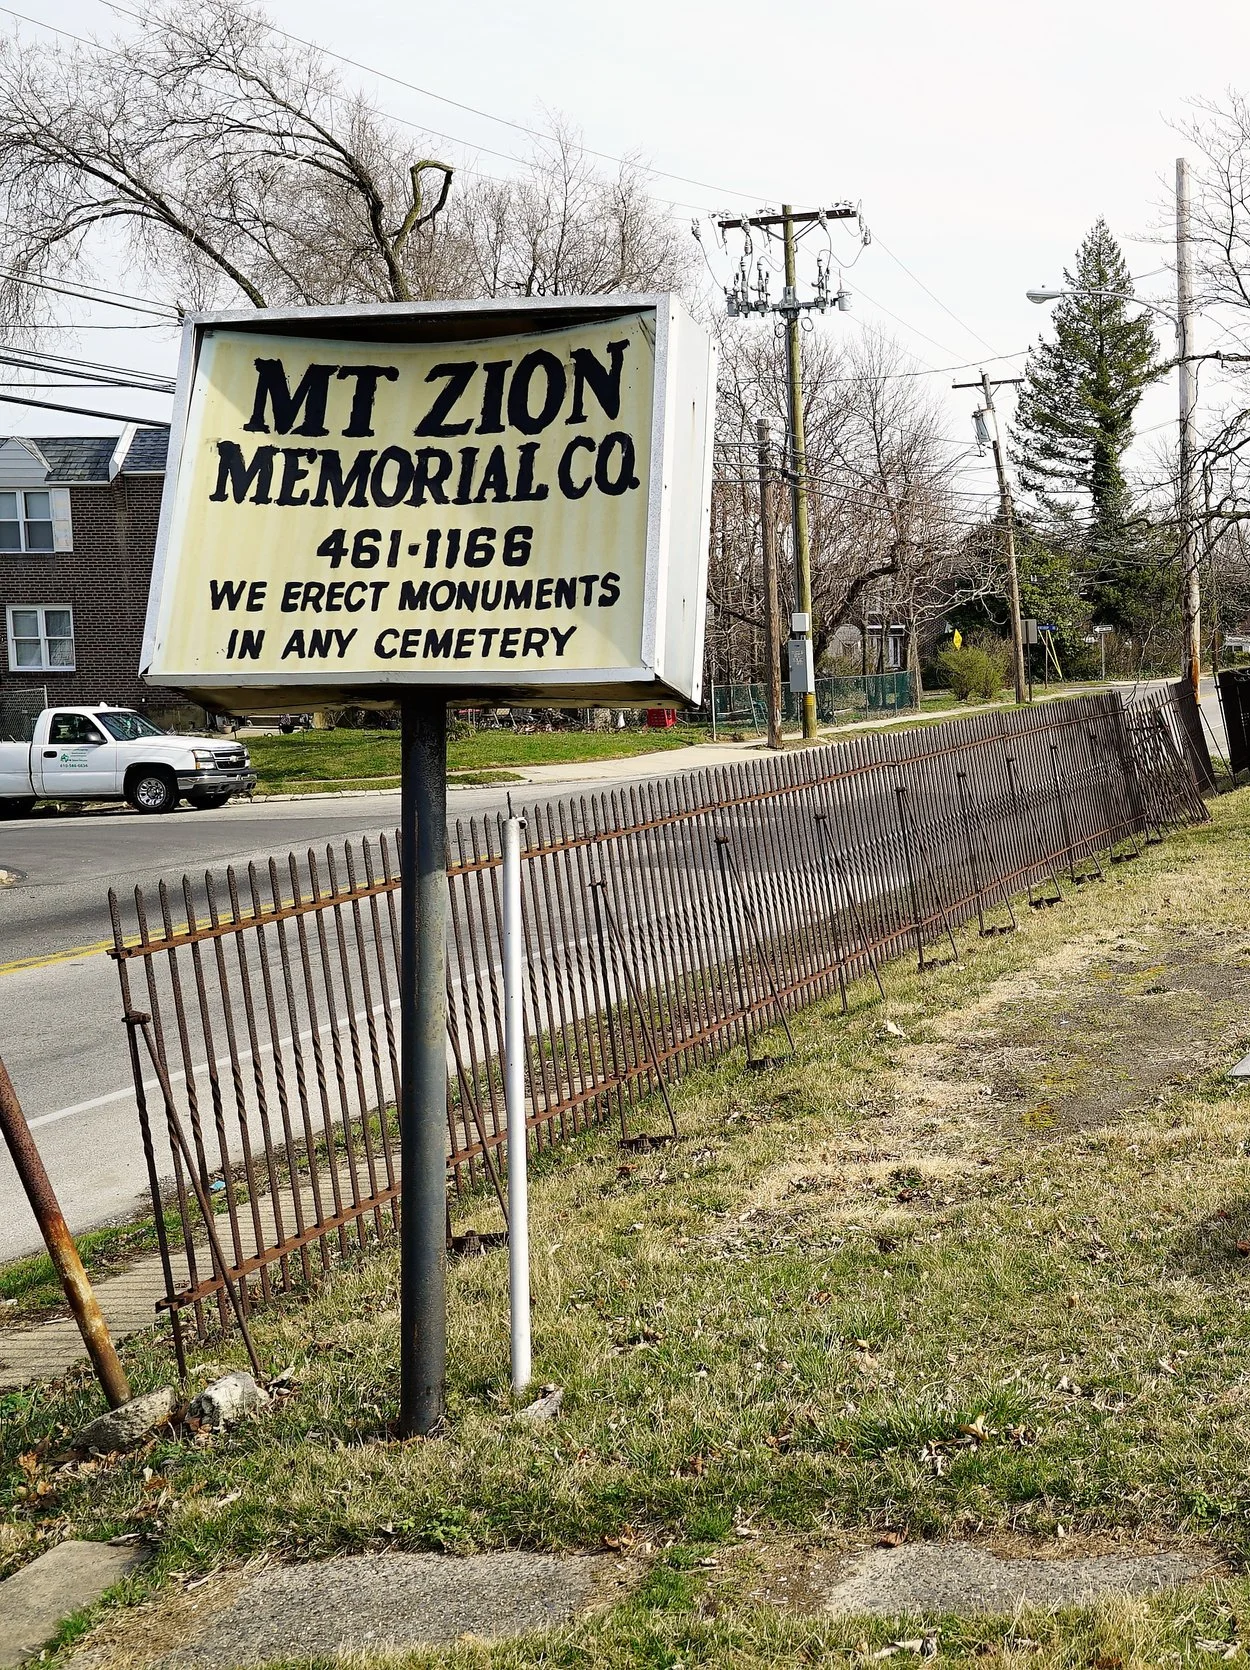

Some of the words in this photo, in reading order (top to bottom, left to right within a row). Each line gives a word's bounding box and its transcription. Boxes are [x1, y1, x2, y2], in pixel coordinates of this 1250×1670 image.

[242, 357, 400, 438] MT
[413, 338, 631, 438] ZION
[208, 440, 550, 508] MEMORIAL
[316, 526, 534, 569] 461-1166
[209, 580, 268, 613] WE
[280, 579, 390, 614] ERECT
[398, 571, 621, 613] MONUMENTS
[226, 628, 266, 660] IN
[280, 627, 358, 660] ANY
[373, 625, 578, 660] CEMETERY
